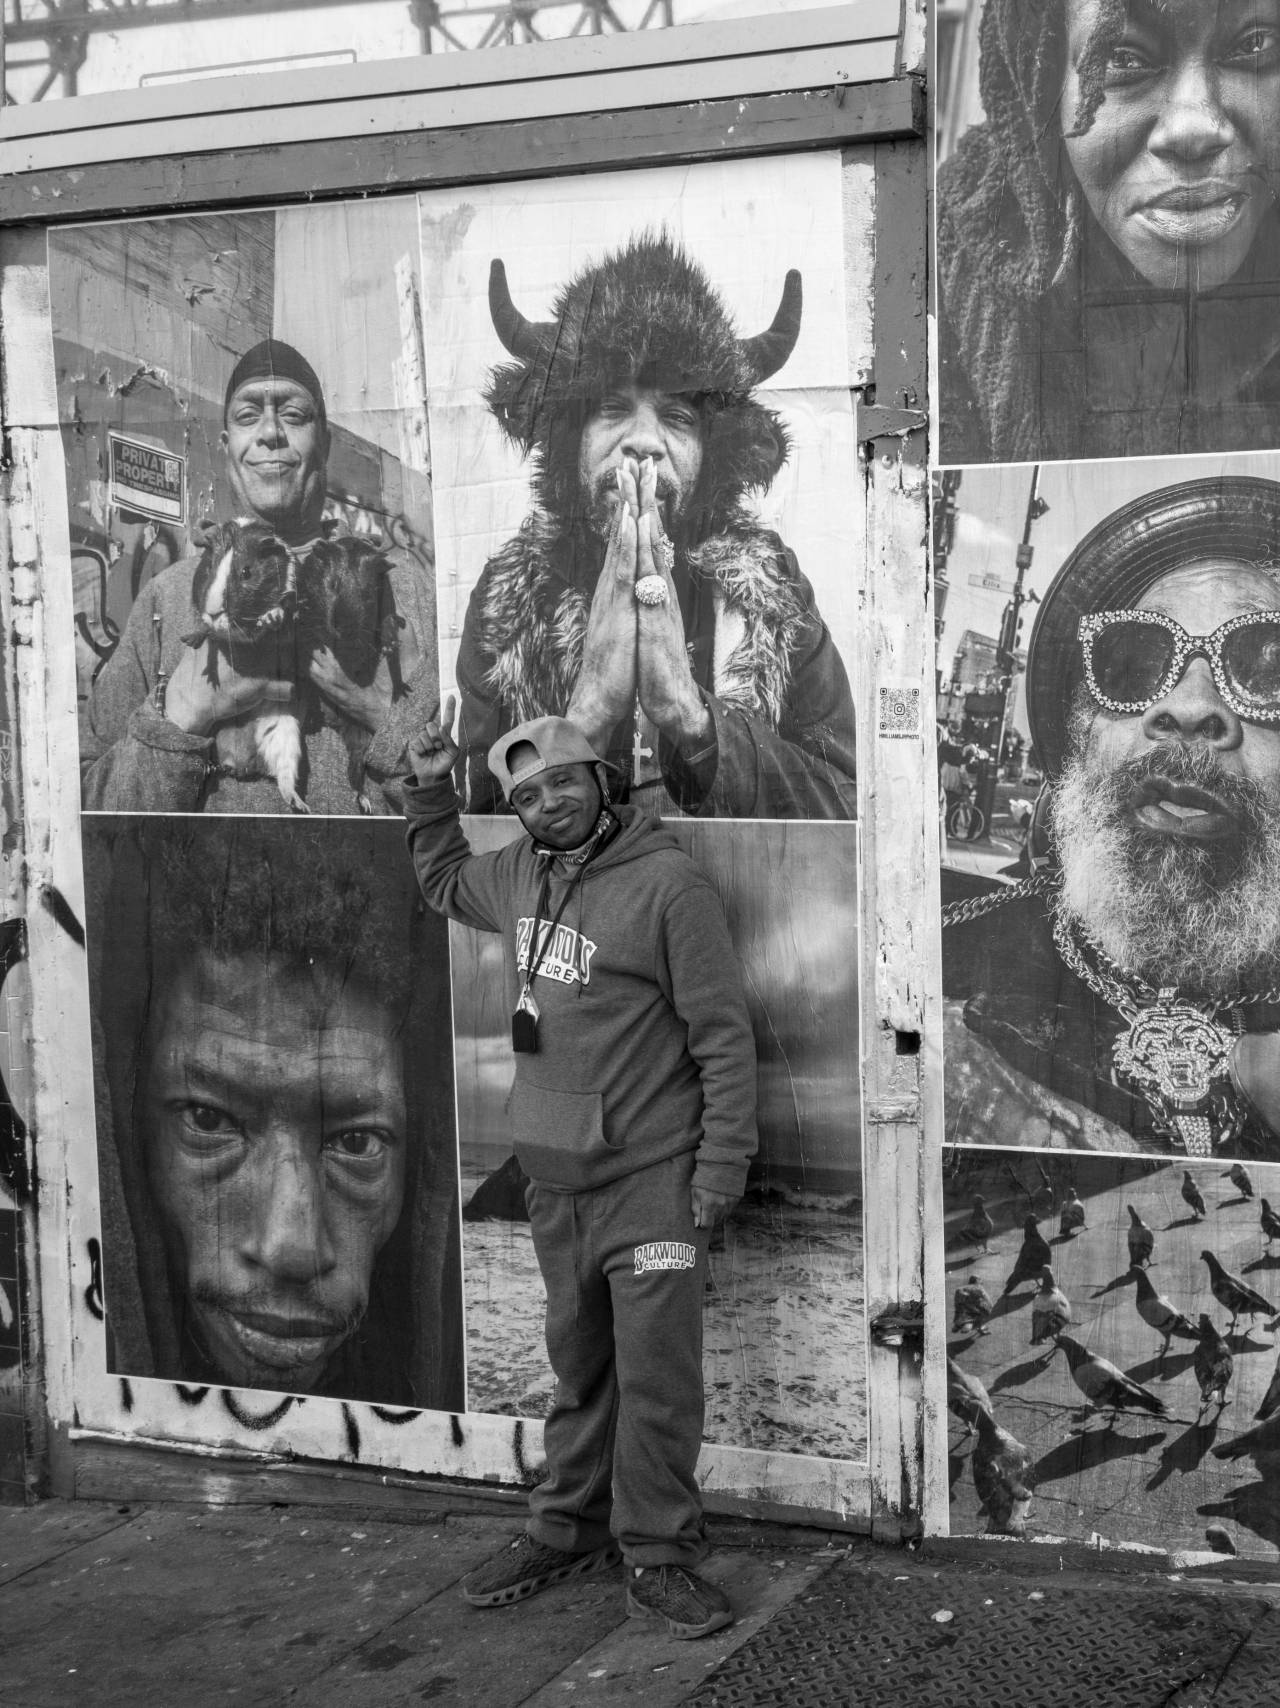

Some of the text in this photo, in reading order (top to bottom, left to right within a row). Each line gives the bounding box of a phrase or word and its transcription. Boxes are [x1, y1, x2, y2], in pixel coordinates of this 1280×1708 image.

[121, 445, 167, 473] PRIVAT
[635, 1243, 696, 1273] BACKWOODS
[644, 1261, 686, 1269] CULTURE
